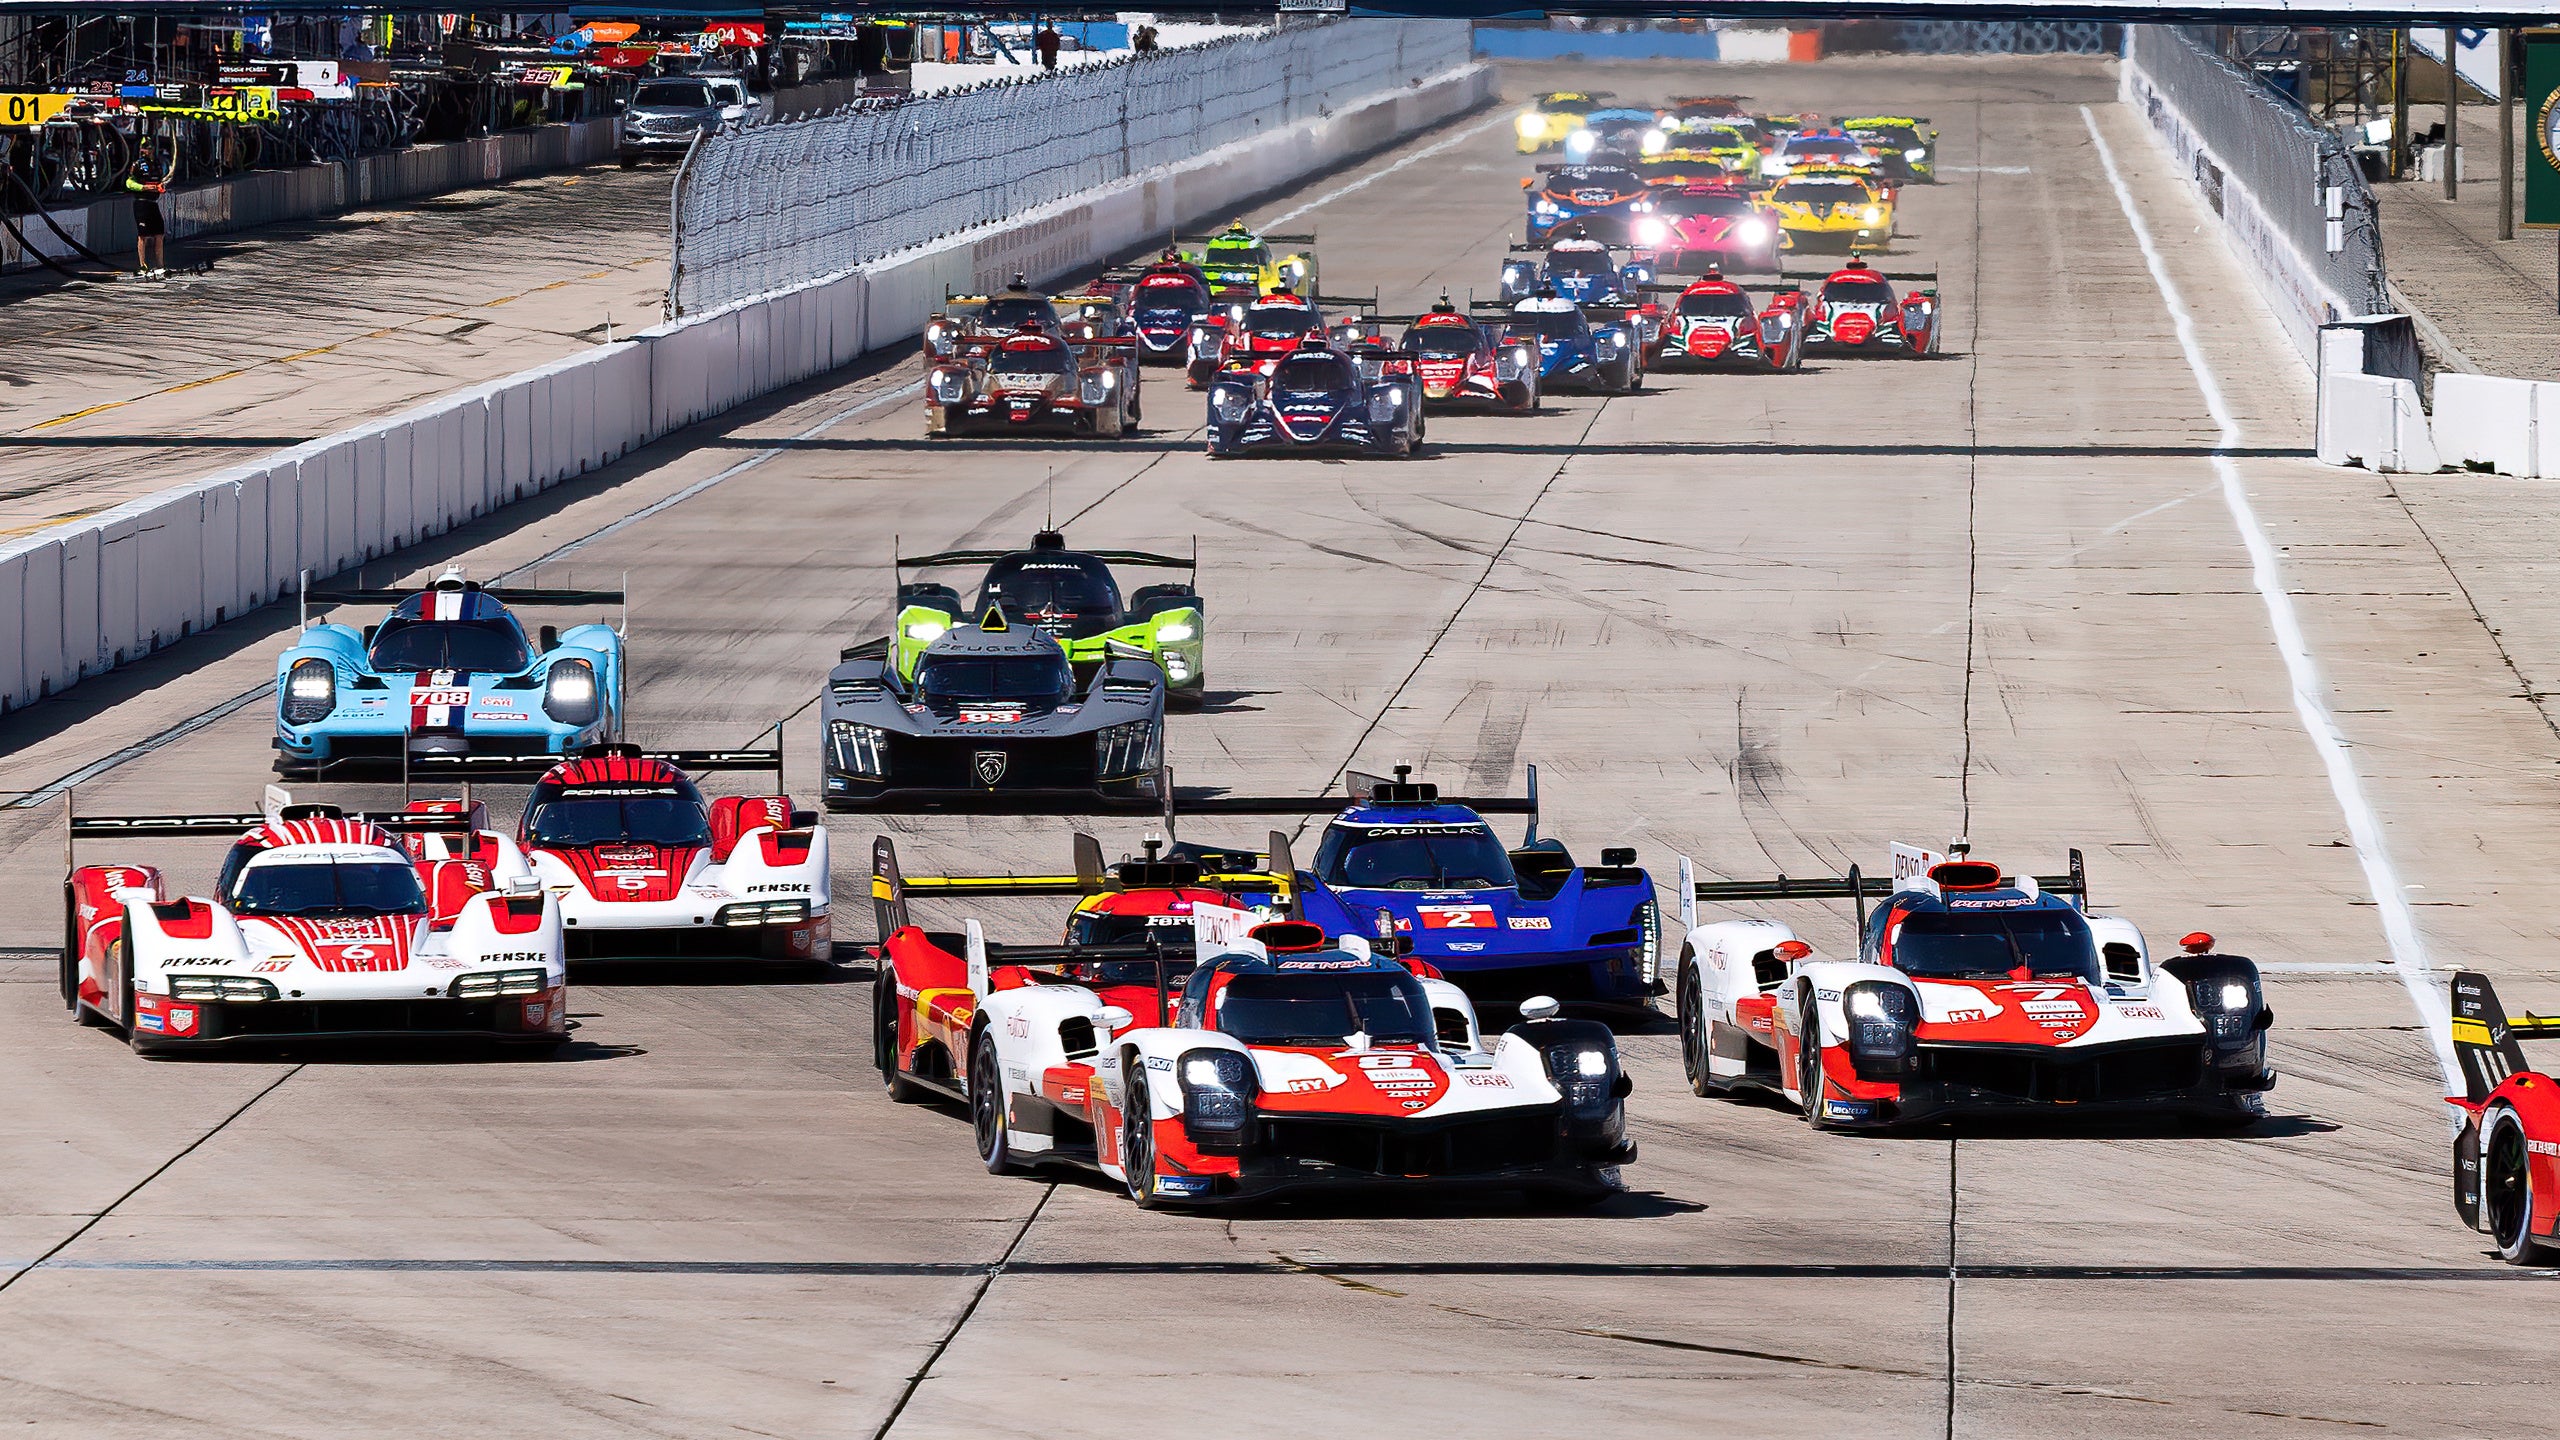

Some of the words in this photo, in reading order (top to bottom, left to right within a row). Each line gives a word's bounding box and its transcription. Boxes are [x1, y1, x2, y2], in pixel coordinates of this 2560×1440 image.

[126, 69, 148, 82] 24
[279, 68, 288, 82] 7
[321, 68, 330, 79] 6
[9, 96, 39, 121] 01
[211, 96, 233, 110] 14
[412, 692, 468, 704] 708
[967, 713, 1014, 722] 93
[562, 788, 678, 796] PORSCHE
[1367, 828, 1485, 837] CADILLAC
[1895, 852, 1920, 881] DENSO
[617, 875, 648, 890] 5
[747, 883, 812, 893] PENSKE
[1950, 899, 2036, 908] DENSO
[1442, 911, 1476, 928] 2
[1199, 914, 1229, 948] DENSO
[341, 945, 375, 959] 6
[481, 952, 546, 963] PENSKE
[1278, 960, 1372, 969] DENSO
[2013, 989, 2067, 1000] 7
[1950, 1010, 1982, 1022] HY
[2122, 1009, 2162, 1019] CAR
[1358, 1056, 1413, 1069] 8
[1289, 1079, 1325, 1093] HY
[1469, 1078, 1511, 1088] CAR
[1386, 1089, 1430, 1098] ZENT
